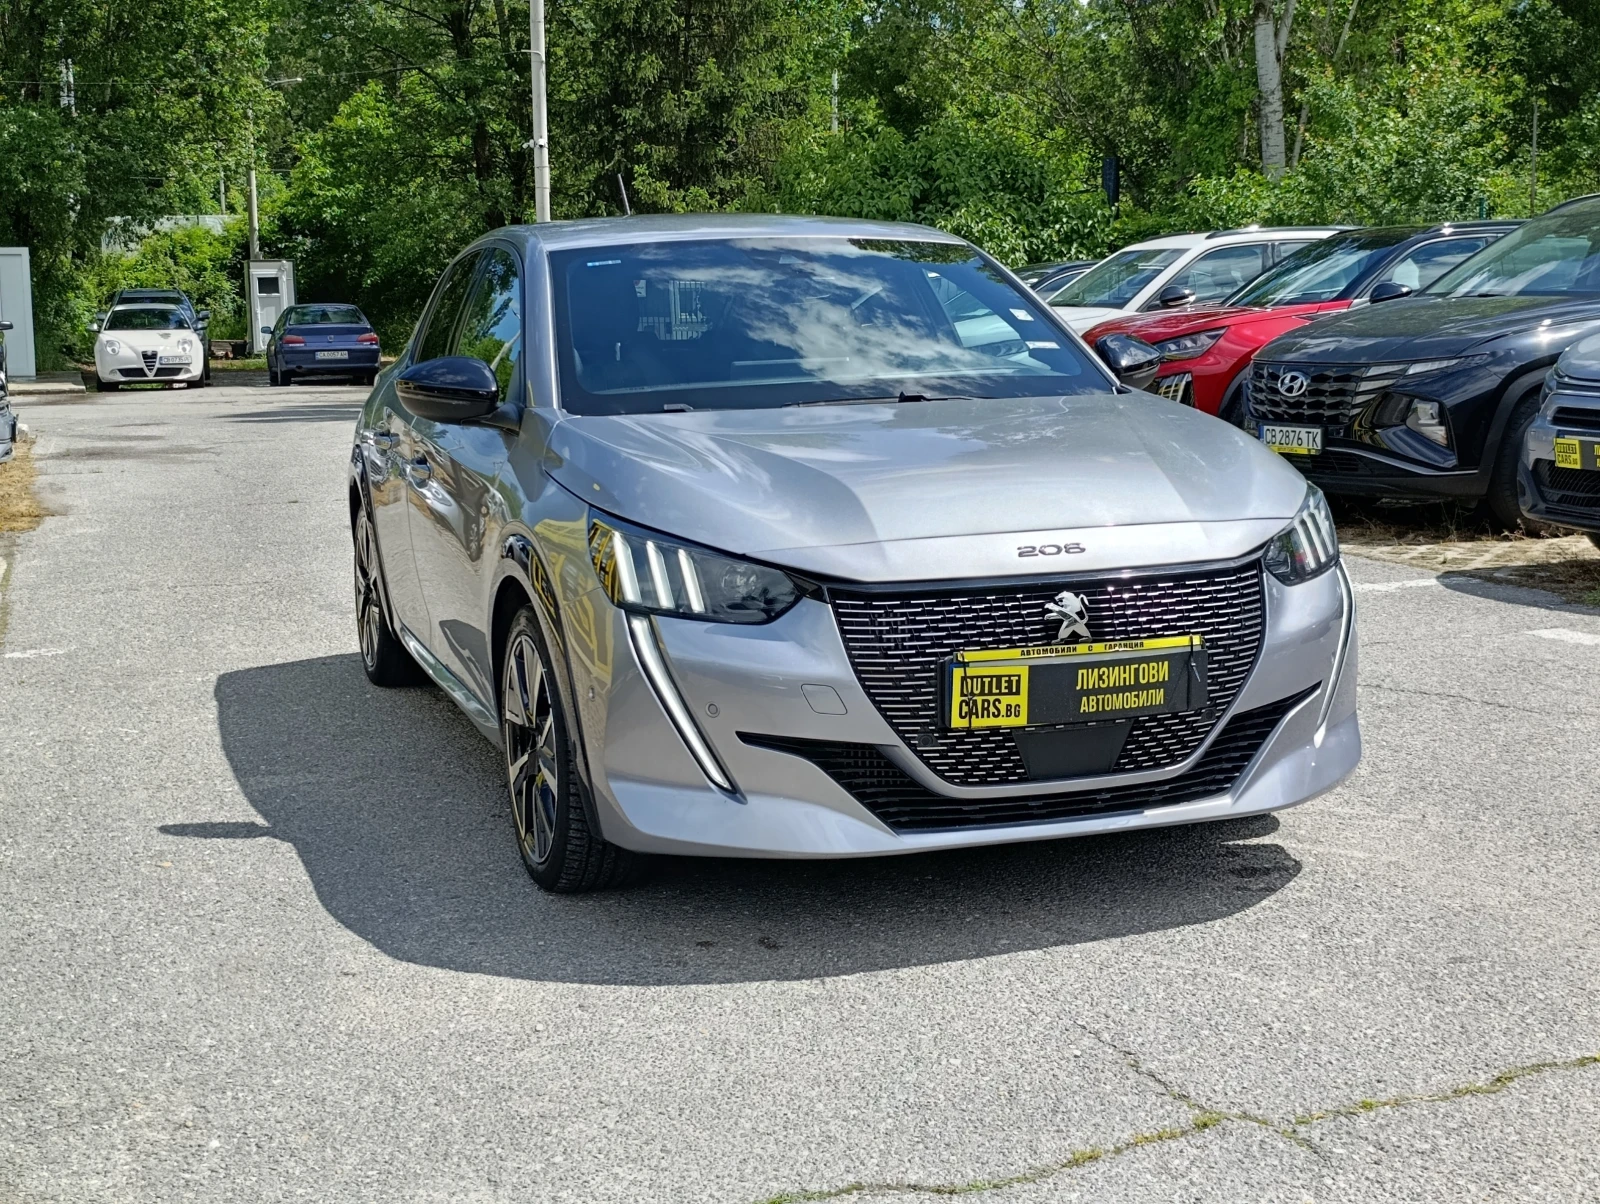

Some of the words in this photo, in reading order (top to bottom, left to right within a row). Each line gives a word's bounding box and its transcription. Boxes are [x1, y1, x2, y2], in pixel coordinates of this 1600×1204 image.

[1265, 428, 1277, 445] CB
[1278, 429, 1303, 447] 2876
[1305, 431, 1319, 448] TK
[1017, 542, 1086, 558] 208
[1020, 646, 1077, 657] АВТОМОБИЛИ
[1104, 641, 1144, 651] ГАРАНЦИЯ
[963, 676, 1019, 695] OUTLET
[1076, 660, 1169, 691] ЛИЗИНГОВИ
[959, 698, 1021, 719] CARS.BG
[1080, 688, 1164, 713] АВТОМОБИЛИ
